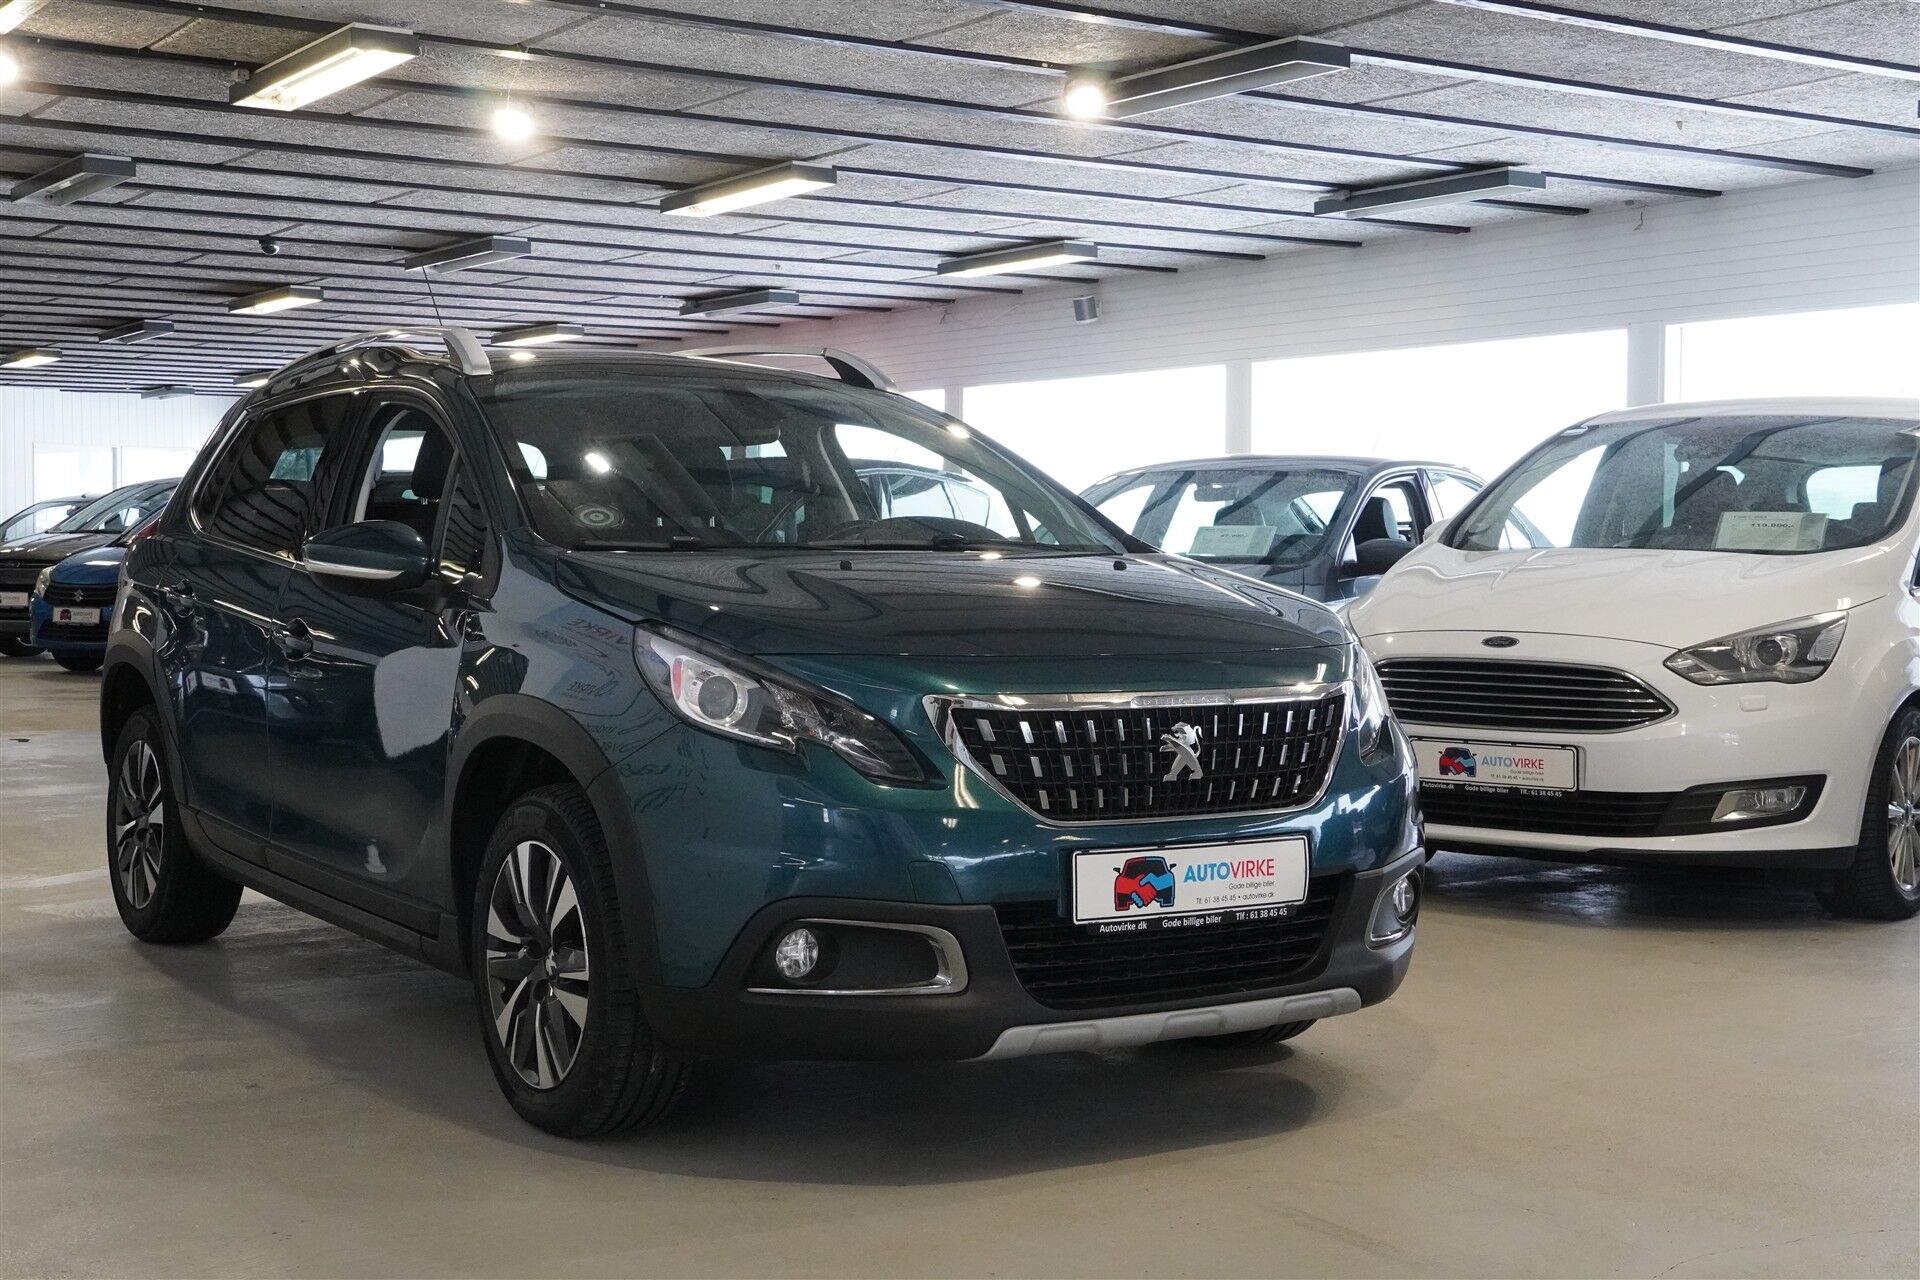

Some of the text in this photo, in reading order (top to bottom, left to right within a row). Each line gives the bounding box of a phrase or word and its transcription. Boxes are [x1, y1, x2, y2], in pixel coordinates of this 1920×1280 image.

[1481, 755, 1544, 770] AUTOVIRKE
[1464, 784, 1479, 792] Gode
[1479, 785, 1496, 793] billige
[1183, 858, 1275, 883] AUTOVIRKE
[1228, 880, 1275, 891] Gode billige biler
[1204, 896, 1211, 904] 61
[1162, 917, 1182, 929] Gode
[1183, 916, 1204, 927] billige
[1205, 915, 1222, 925] biler
[1249, 910, 1258, 919] 61
[1259, 909, 1268, 918] 38
[1269, 908, 1278, 917] 45
[1278, 907, 1288, 916] 45
